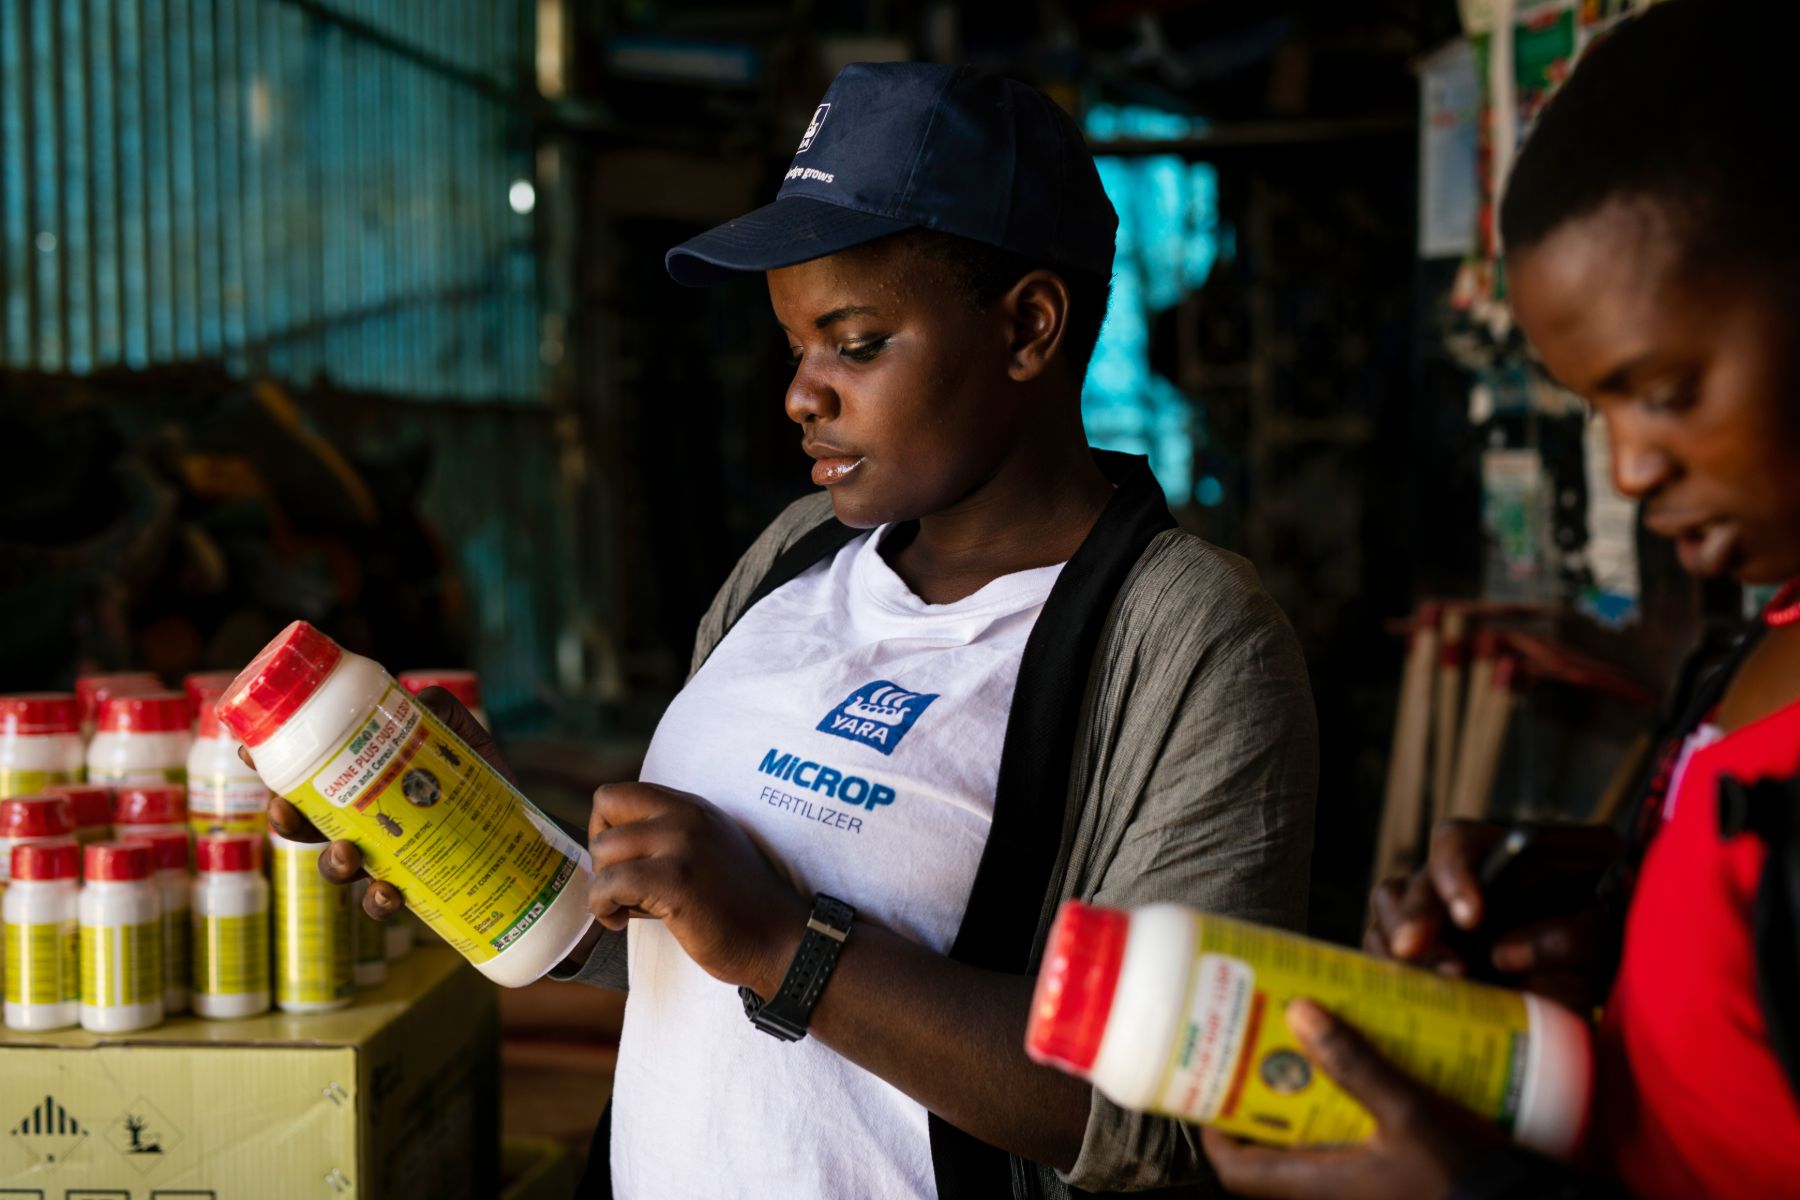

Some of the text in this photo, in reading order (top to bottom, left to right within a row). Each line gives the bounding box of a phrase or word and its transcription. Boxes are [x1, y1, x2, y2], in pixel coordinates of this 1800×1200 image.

[802, 168, 834, 183] grows
[831, 714, 889, 745] YARA
[324, 766, 358, 798] CANINE
[355, 742, 380, 769] PLUS
[376, 721, 397, 745] DUST
[338, 783, 360, 804] Grain
[356, 768, 373, 786] and
[372, 746, 395, 771] Cereal
[757, 748, 896, 812] MICROP
[760, 786, 863, 834] FERTILIZER
[467, 884, 479, 897] NET
